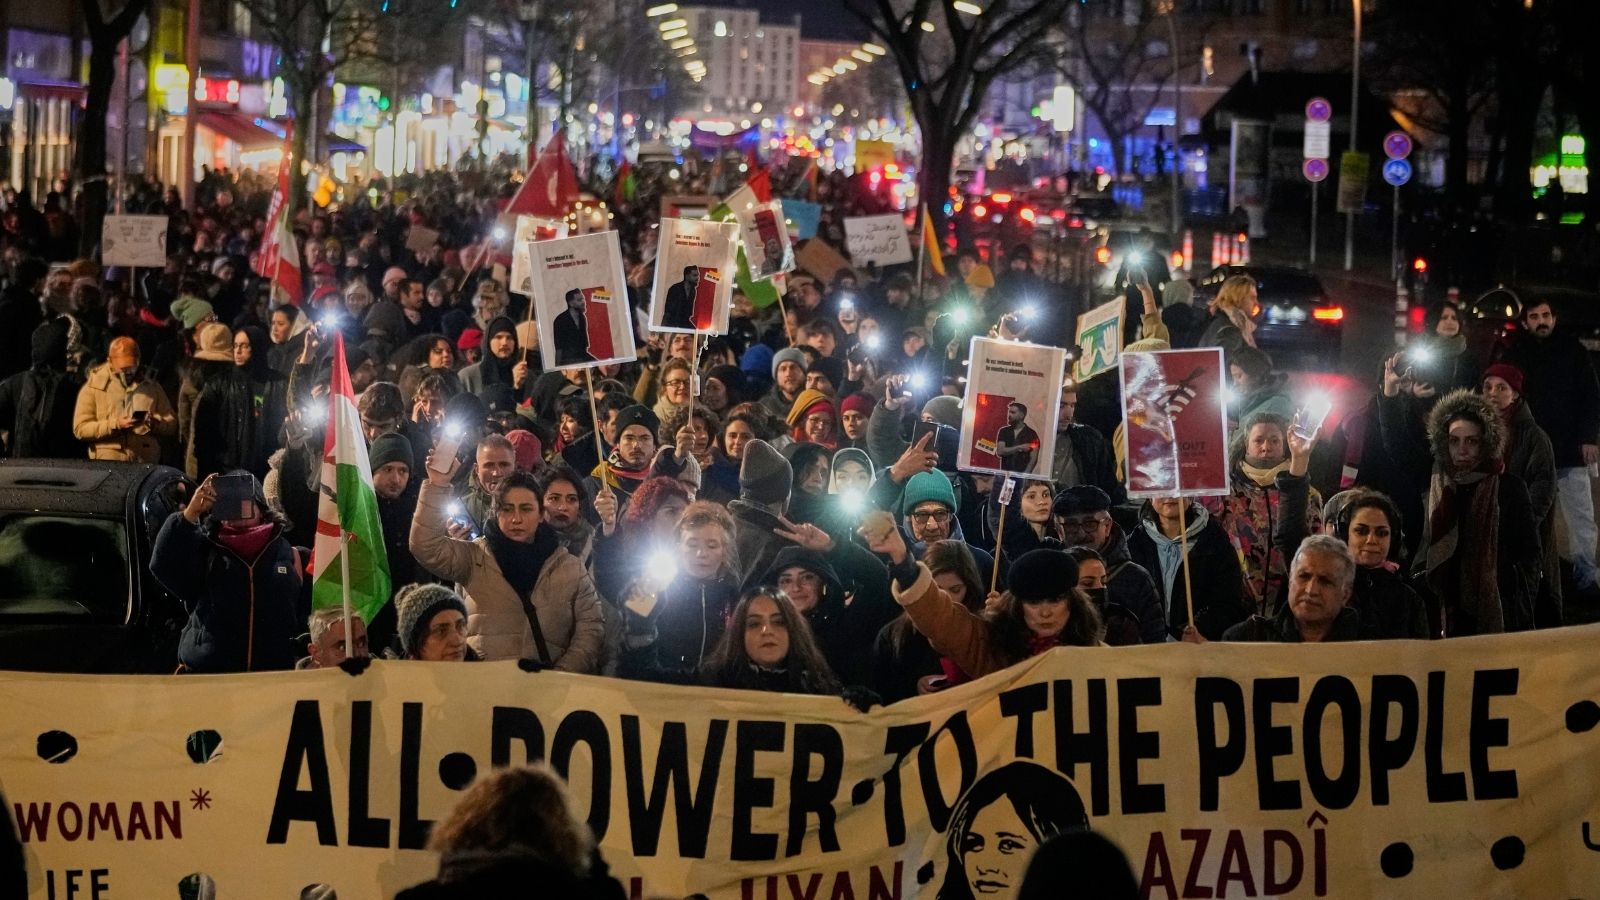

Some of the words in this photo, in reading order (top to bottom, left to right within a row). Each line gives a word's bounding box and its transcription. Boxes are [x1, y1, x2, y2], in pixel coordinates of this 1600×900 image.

[266, 699, 438, 851] ALL
[884, 710, 978, 847] TO
[998, 677, 1166, 817] THE
[1194, 667, 1519, 811] PEOPLE
[1137, 809, 1329, 900] AZADÎ
